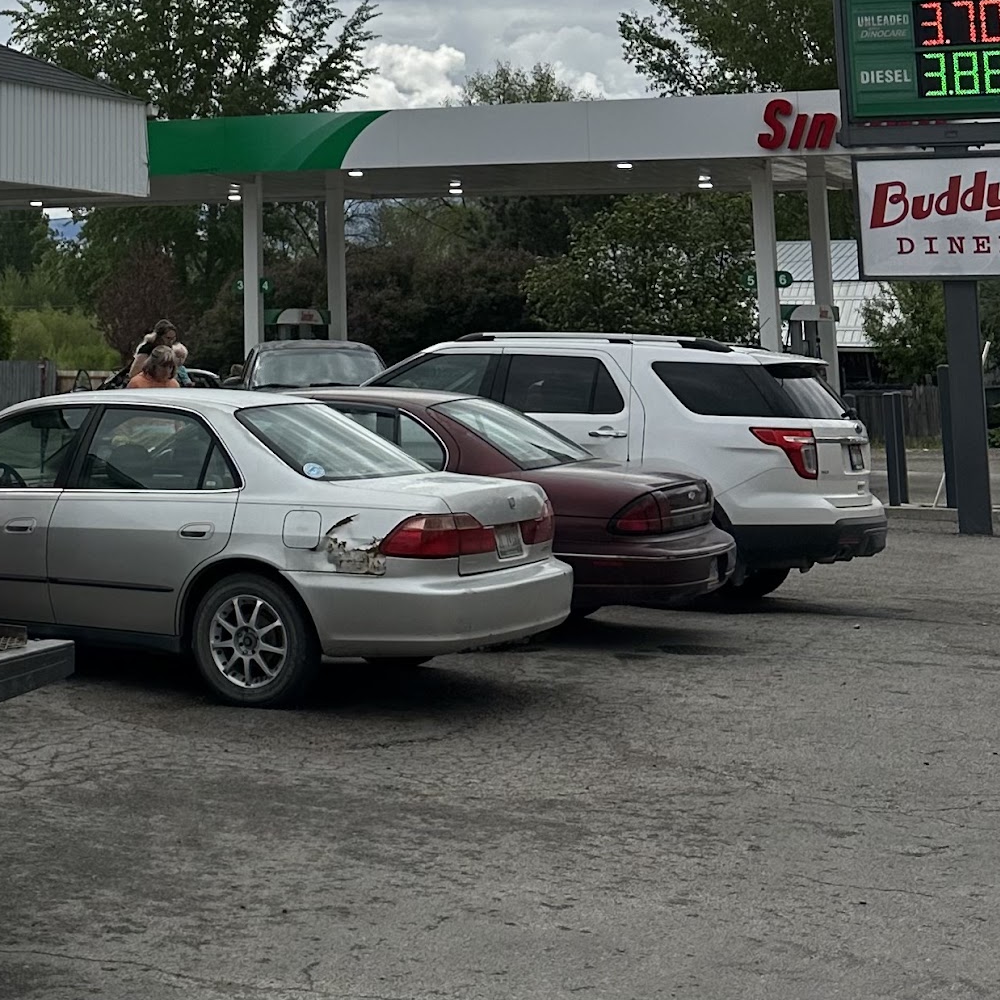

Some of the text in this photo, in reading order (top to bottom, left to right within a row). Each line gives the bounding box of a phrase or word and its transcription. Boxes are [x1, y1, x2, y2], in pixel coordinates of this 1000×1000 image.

[857, 14, 909, 27] UNLEADED
[860, 69, 912, 84] DIESEL
[896, 236, 1000, 255] DINE
[746, 275, 755, 286] 5
[778, 274, 787, 285] 6
[237, 281, 244, 290] 3
[262, 281, 269, 290] 4
